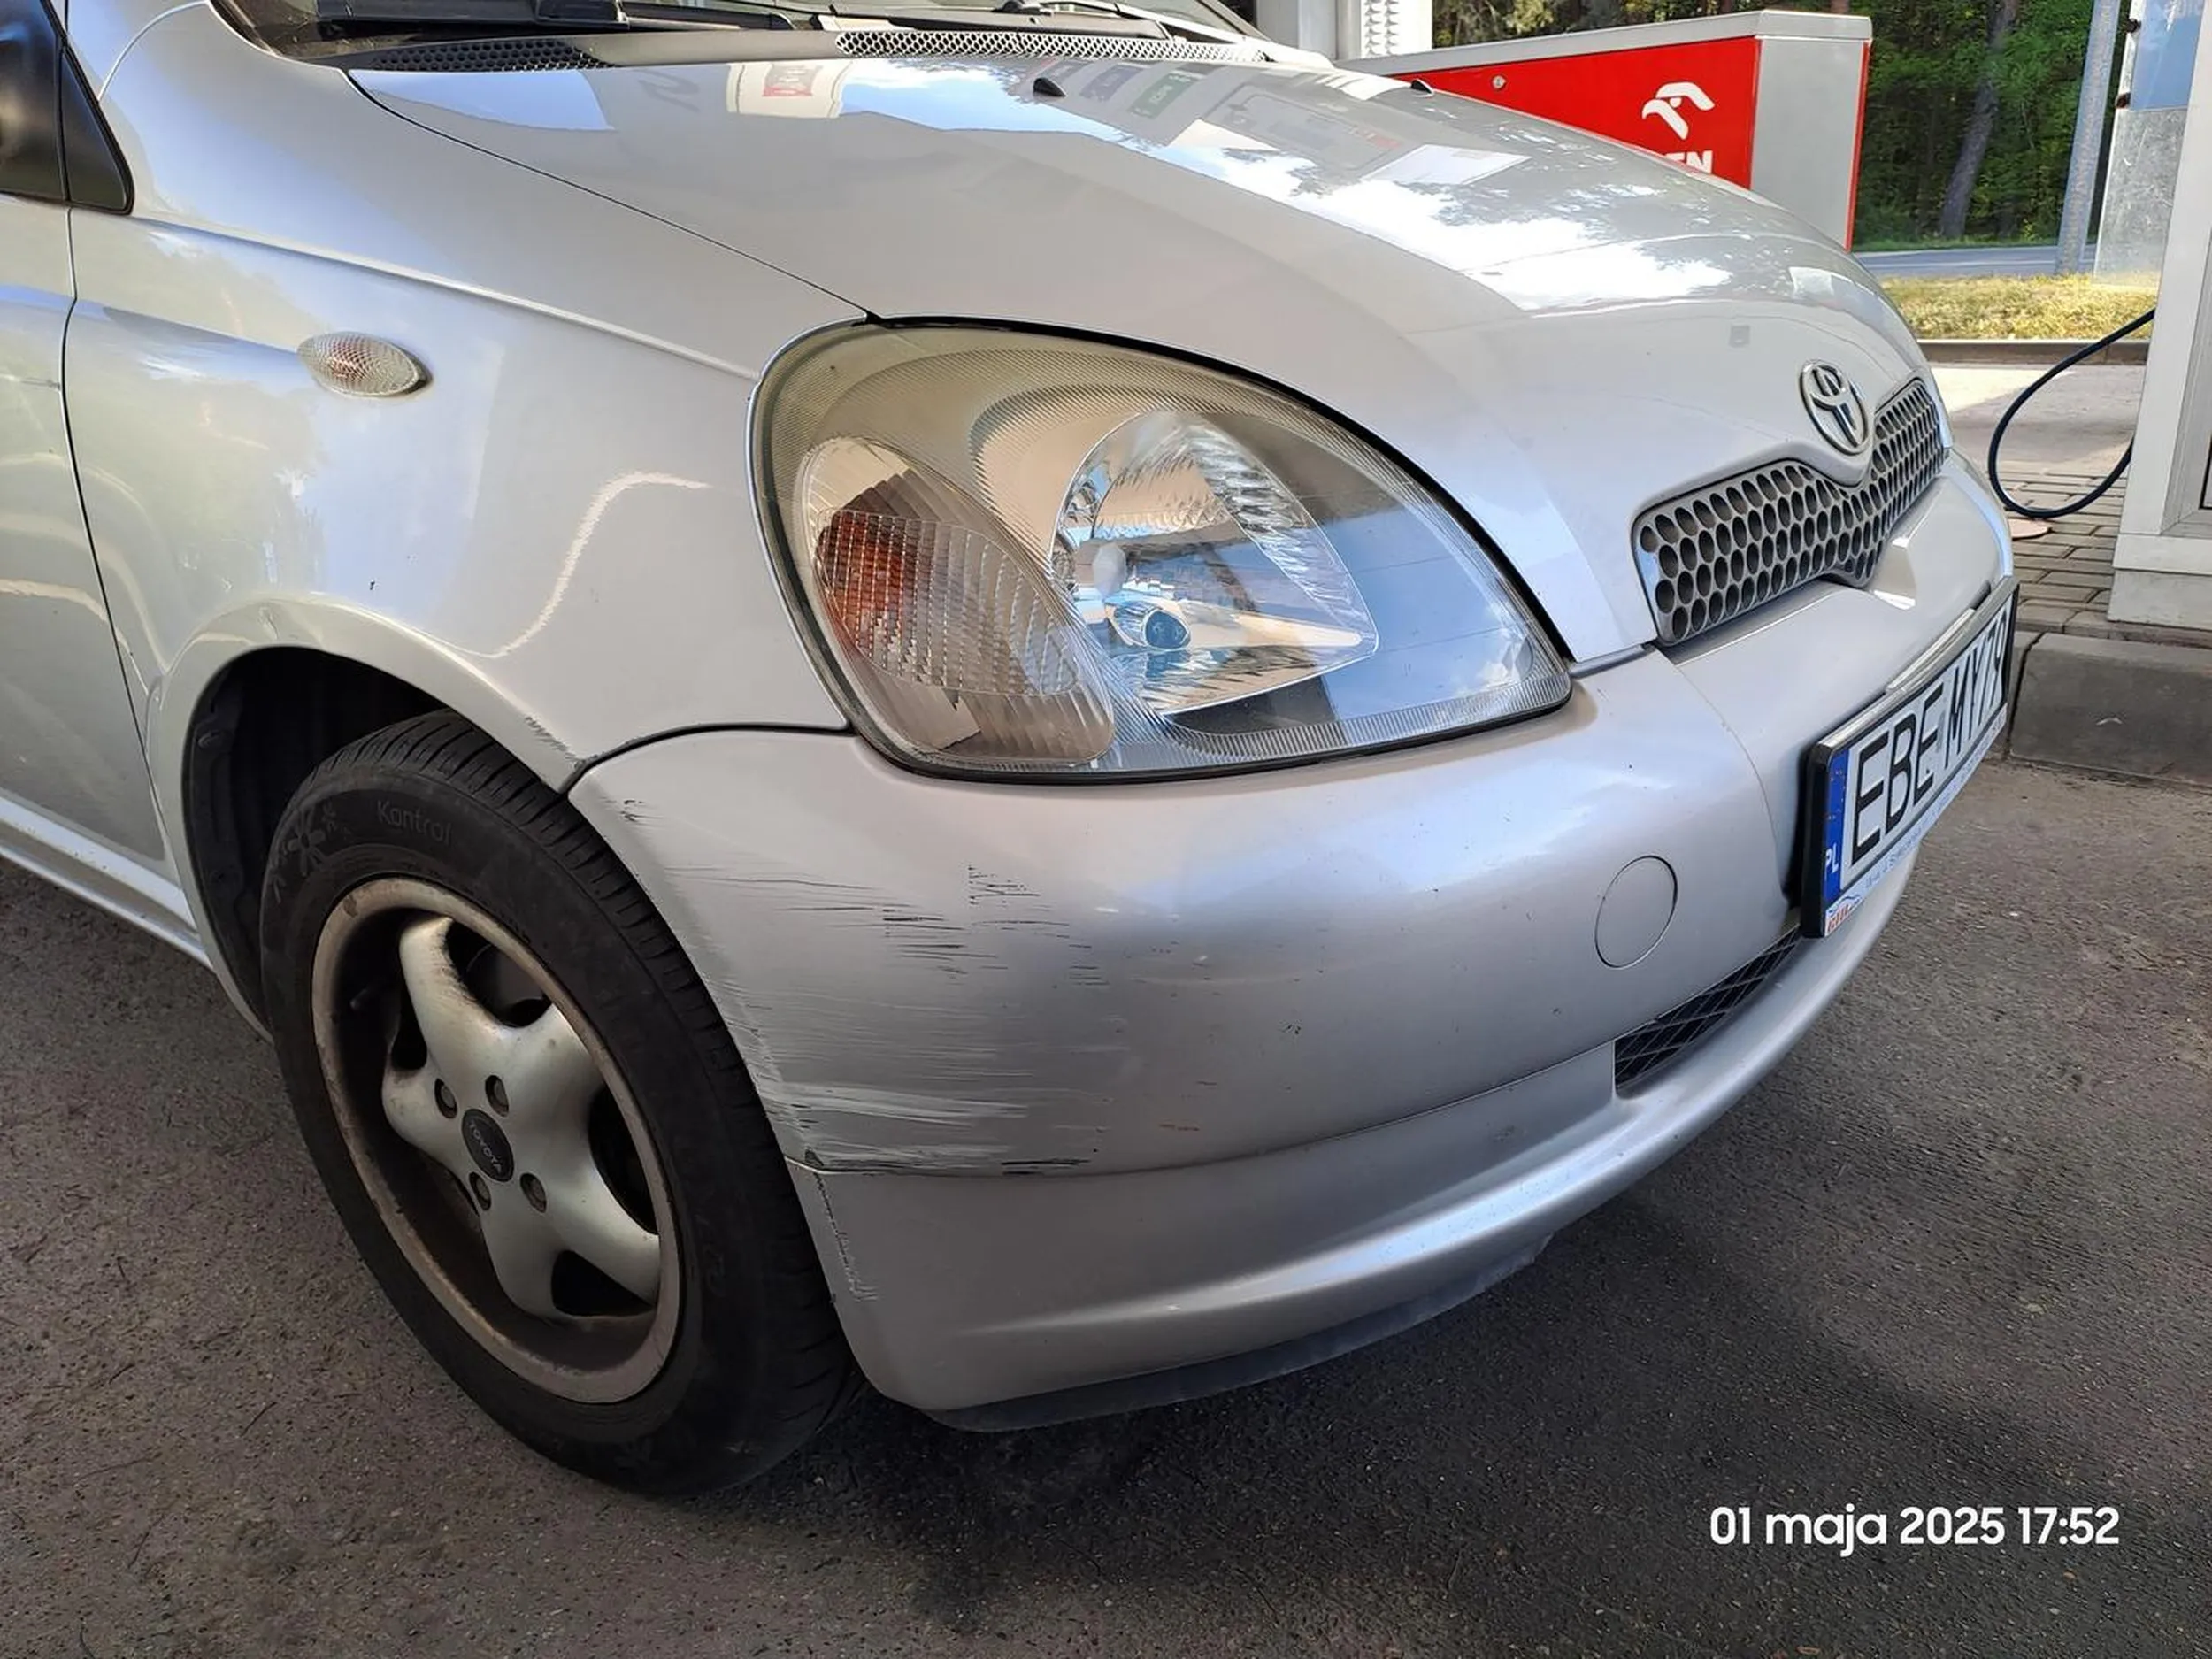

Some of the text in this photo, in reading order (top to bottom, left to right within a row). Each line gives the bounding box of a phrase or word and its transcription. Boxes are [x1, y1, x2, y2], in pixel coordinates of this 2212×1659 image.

[1852, 682, 1943, 866] EBE
[1946, 610, 2007, 768] MY79
[1824, 842, 1839, 881] PL
[467, 1120, 503, 1174] TOYOTA
